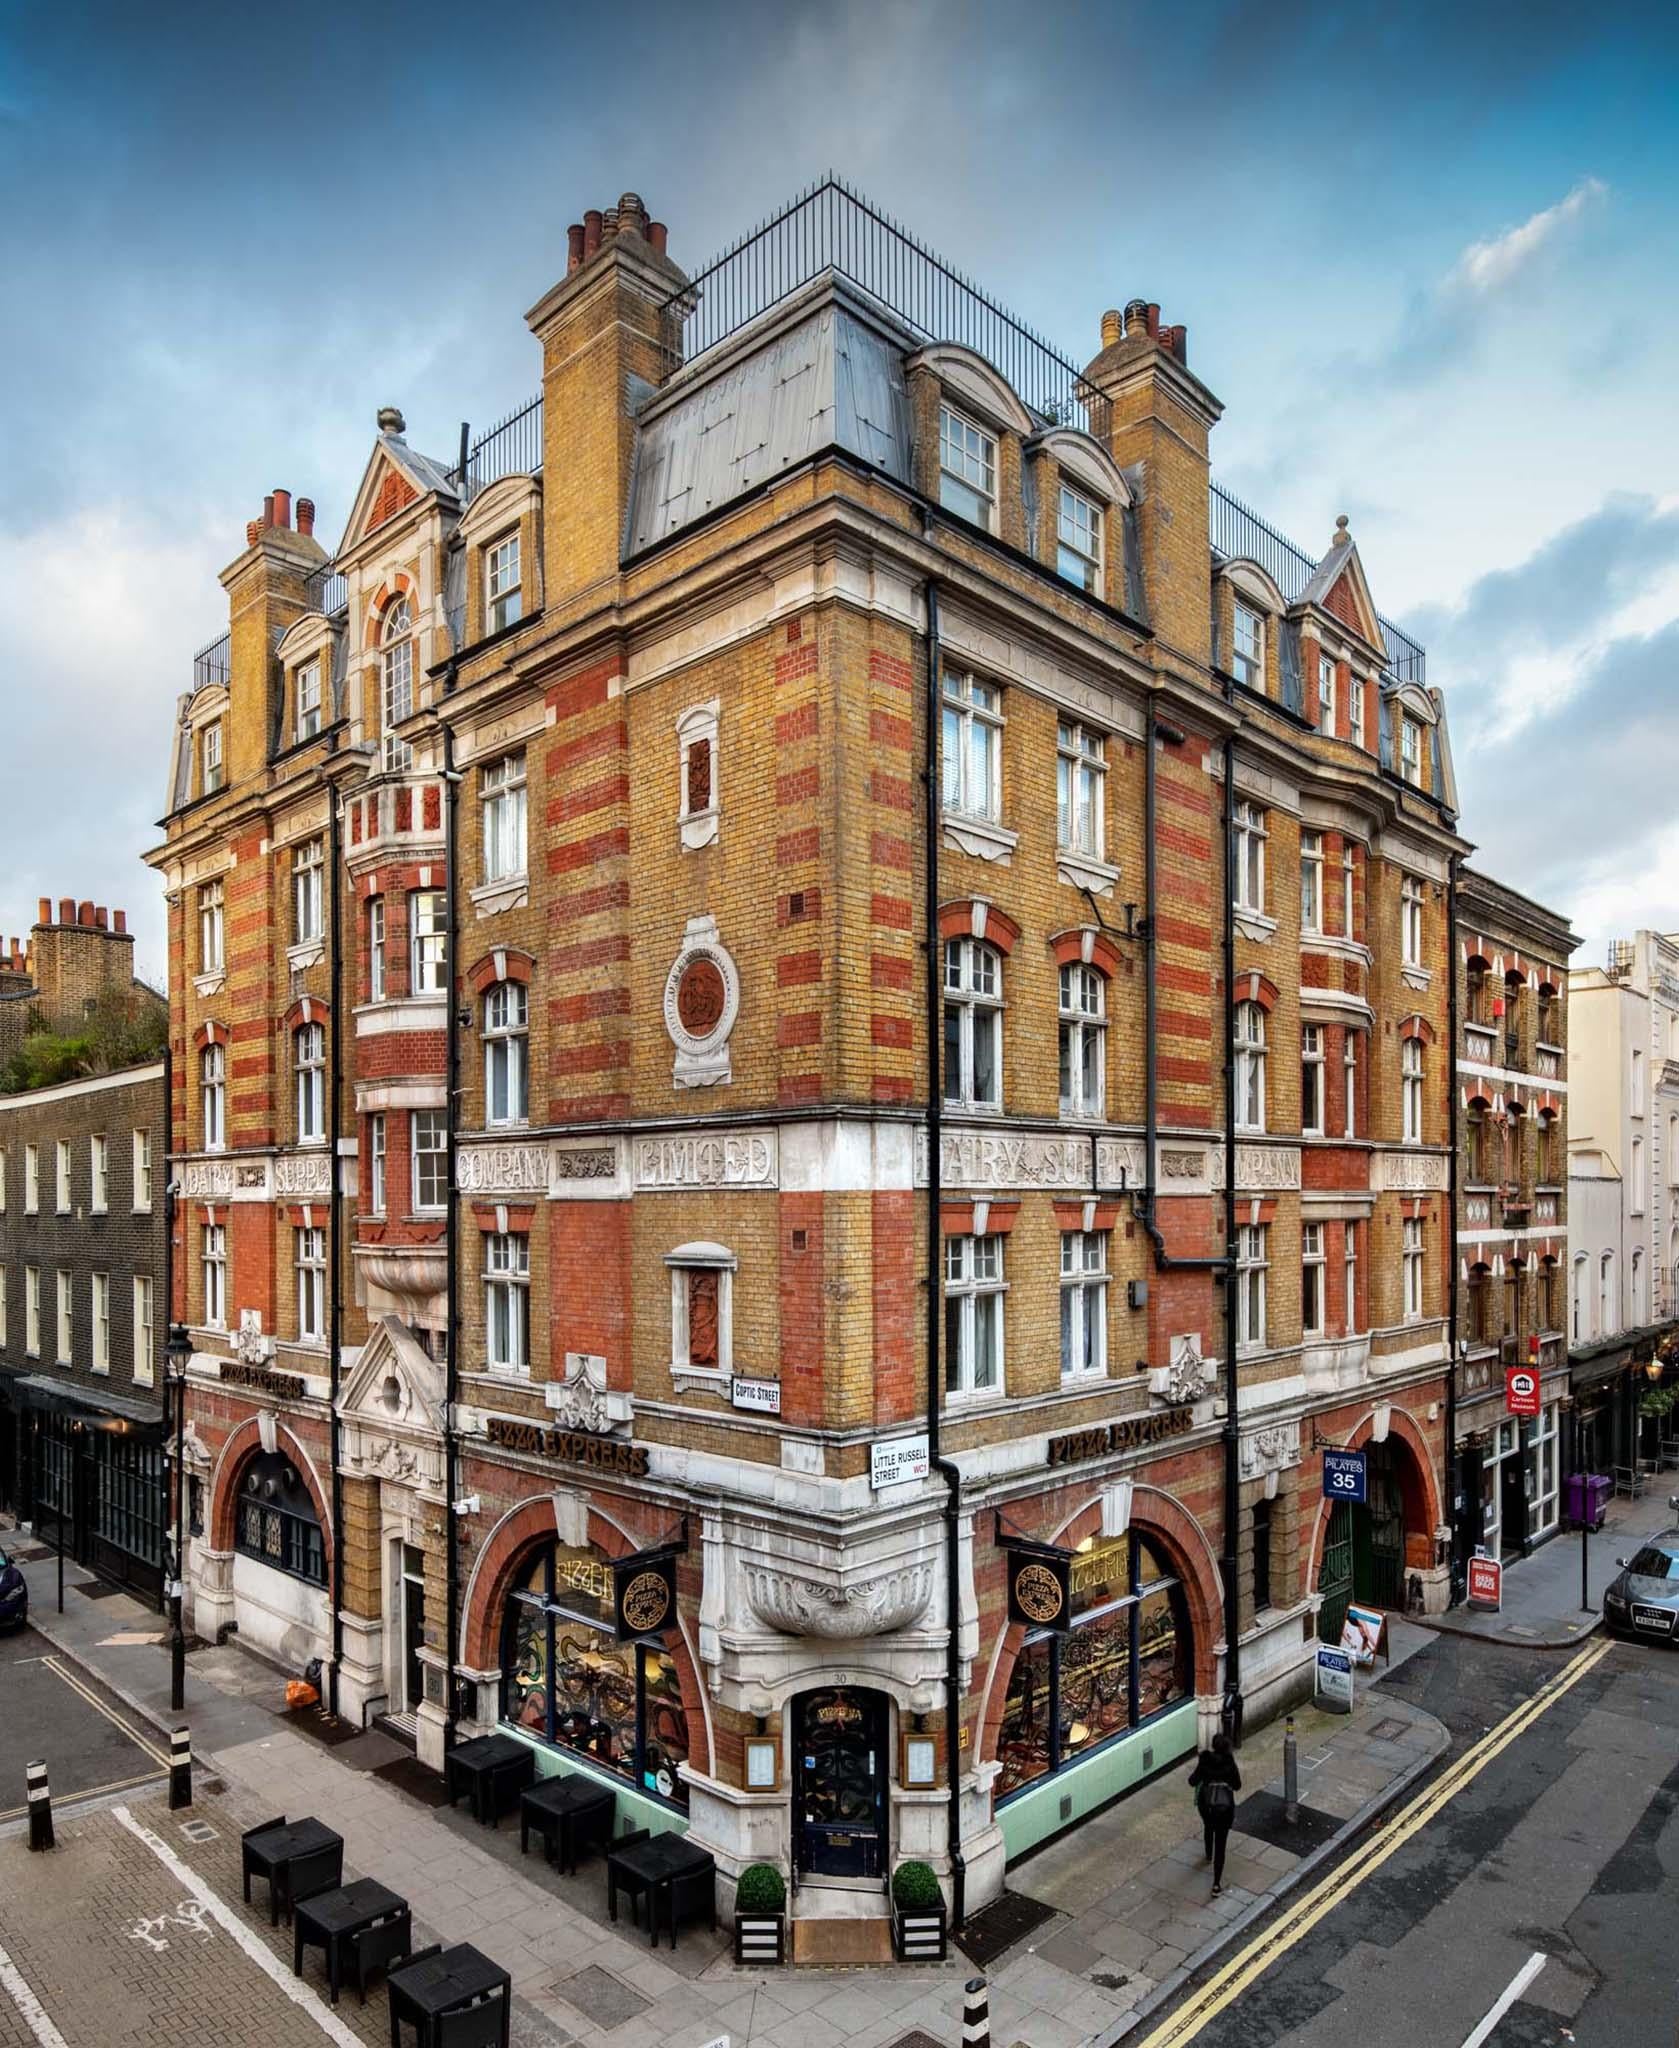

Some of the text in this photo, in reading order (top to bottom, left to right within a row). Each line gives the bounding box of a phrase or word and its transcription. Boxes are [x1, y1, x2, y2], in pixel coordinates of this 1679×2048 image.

[457, 1135, 771, 1190] COMPANY LIMITED
[1209, 1149, 1299, 1186] CMPANY
[187, 1163, 233, 1195] DAIRY
[736, 1383, 756, 1400] COPTIC
[757, 1386, 779, 1403] STREET
[487, 1418, 650, 1476] PIZZA EXPRESS
[1048, 1407, 1194, 1467] PIZZA EXPRESS
[874, 1448, 927, 1468] LITTLE RUSSELL
[1325, 1460, 1363, 1473] PILATES
[874, 1467, 900, 1483] STREET
[913, 1464, 927, 1474] WC1
[1333, 1472, 1355, 1489] 35
[1071, 1551, 1128, 1595] IZZERIA
[635, 1591, 657, 1602] PIZZA
[1027, 1582, 1050, 1593] PIZZA
